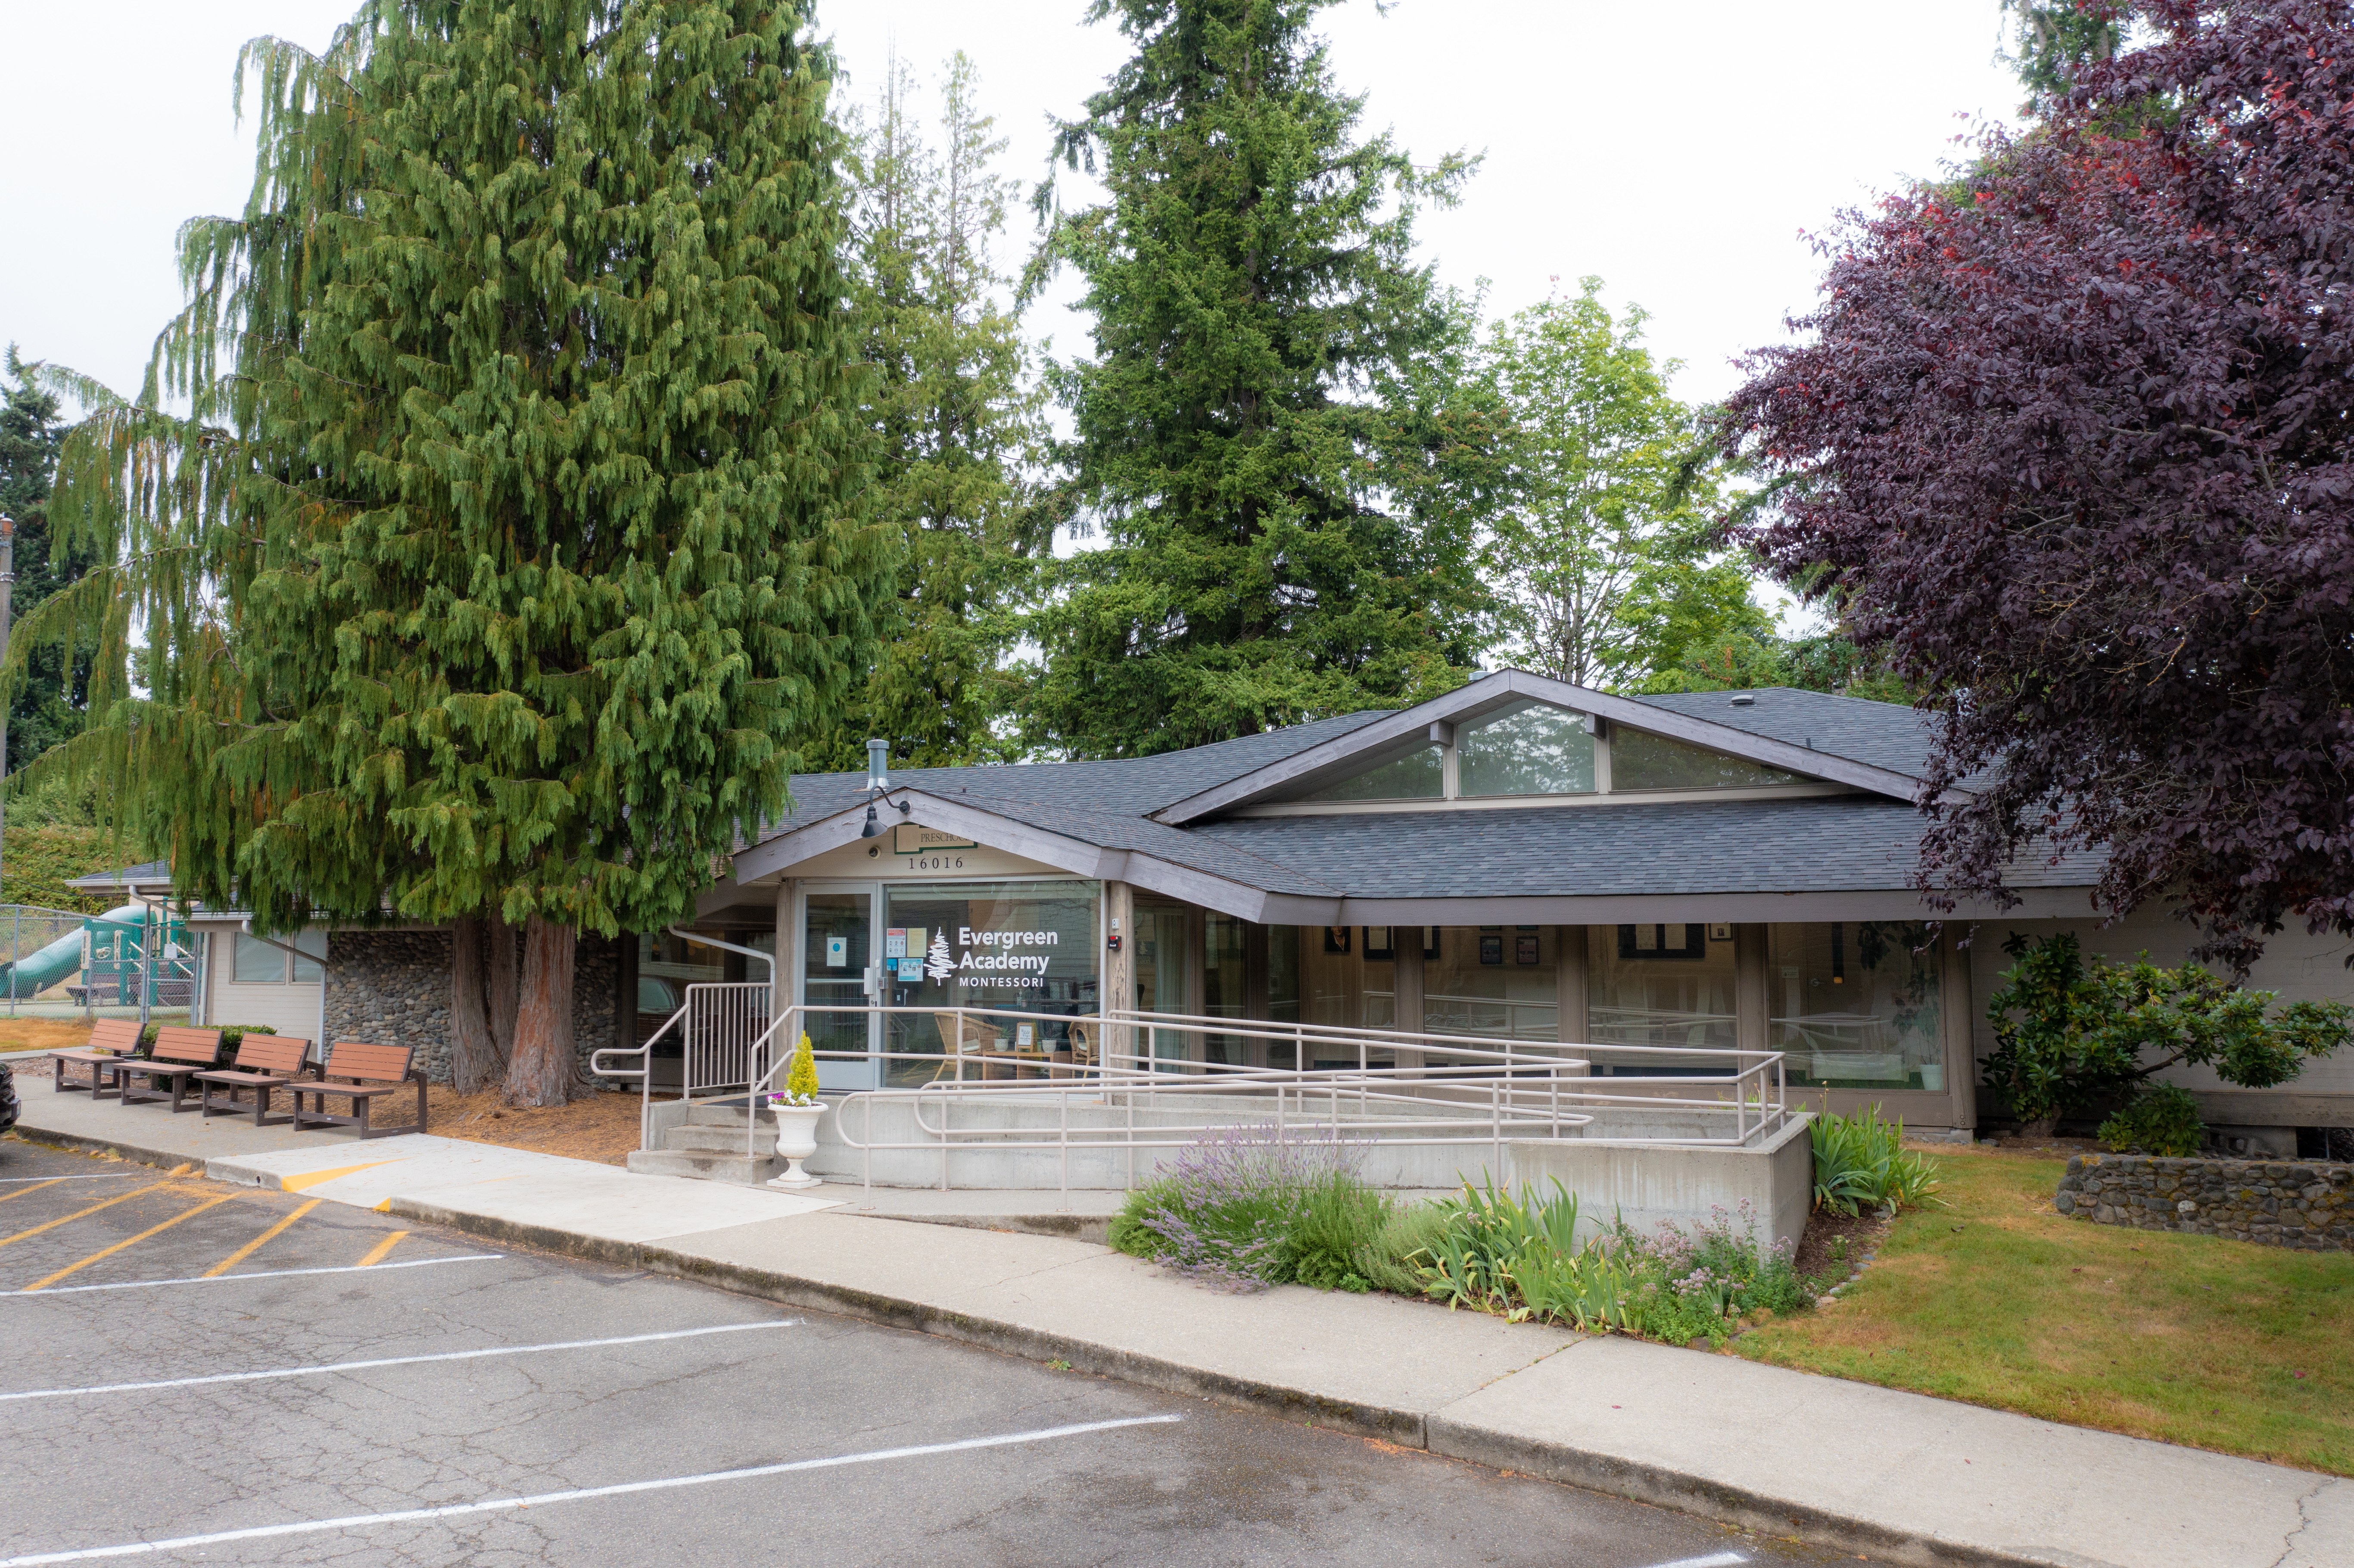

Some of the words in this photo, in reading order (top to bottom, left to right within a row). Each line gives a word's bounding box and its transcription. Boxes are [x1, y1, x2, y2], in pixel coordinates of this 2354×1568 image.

[921, 833, 970, 842] PRESCHO
[909, 857, 962, 869] 16016
[959, 927, 1058, 949] Evergreen
[959, 951, 1050, 975] Academy
[959, 977, 1043, 987] MONTESSORI
